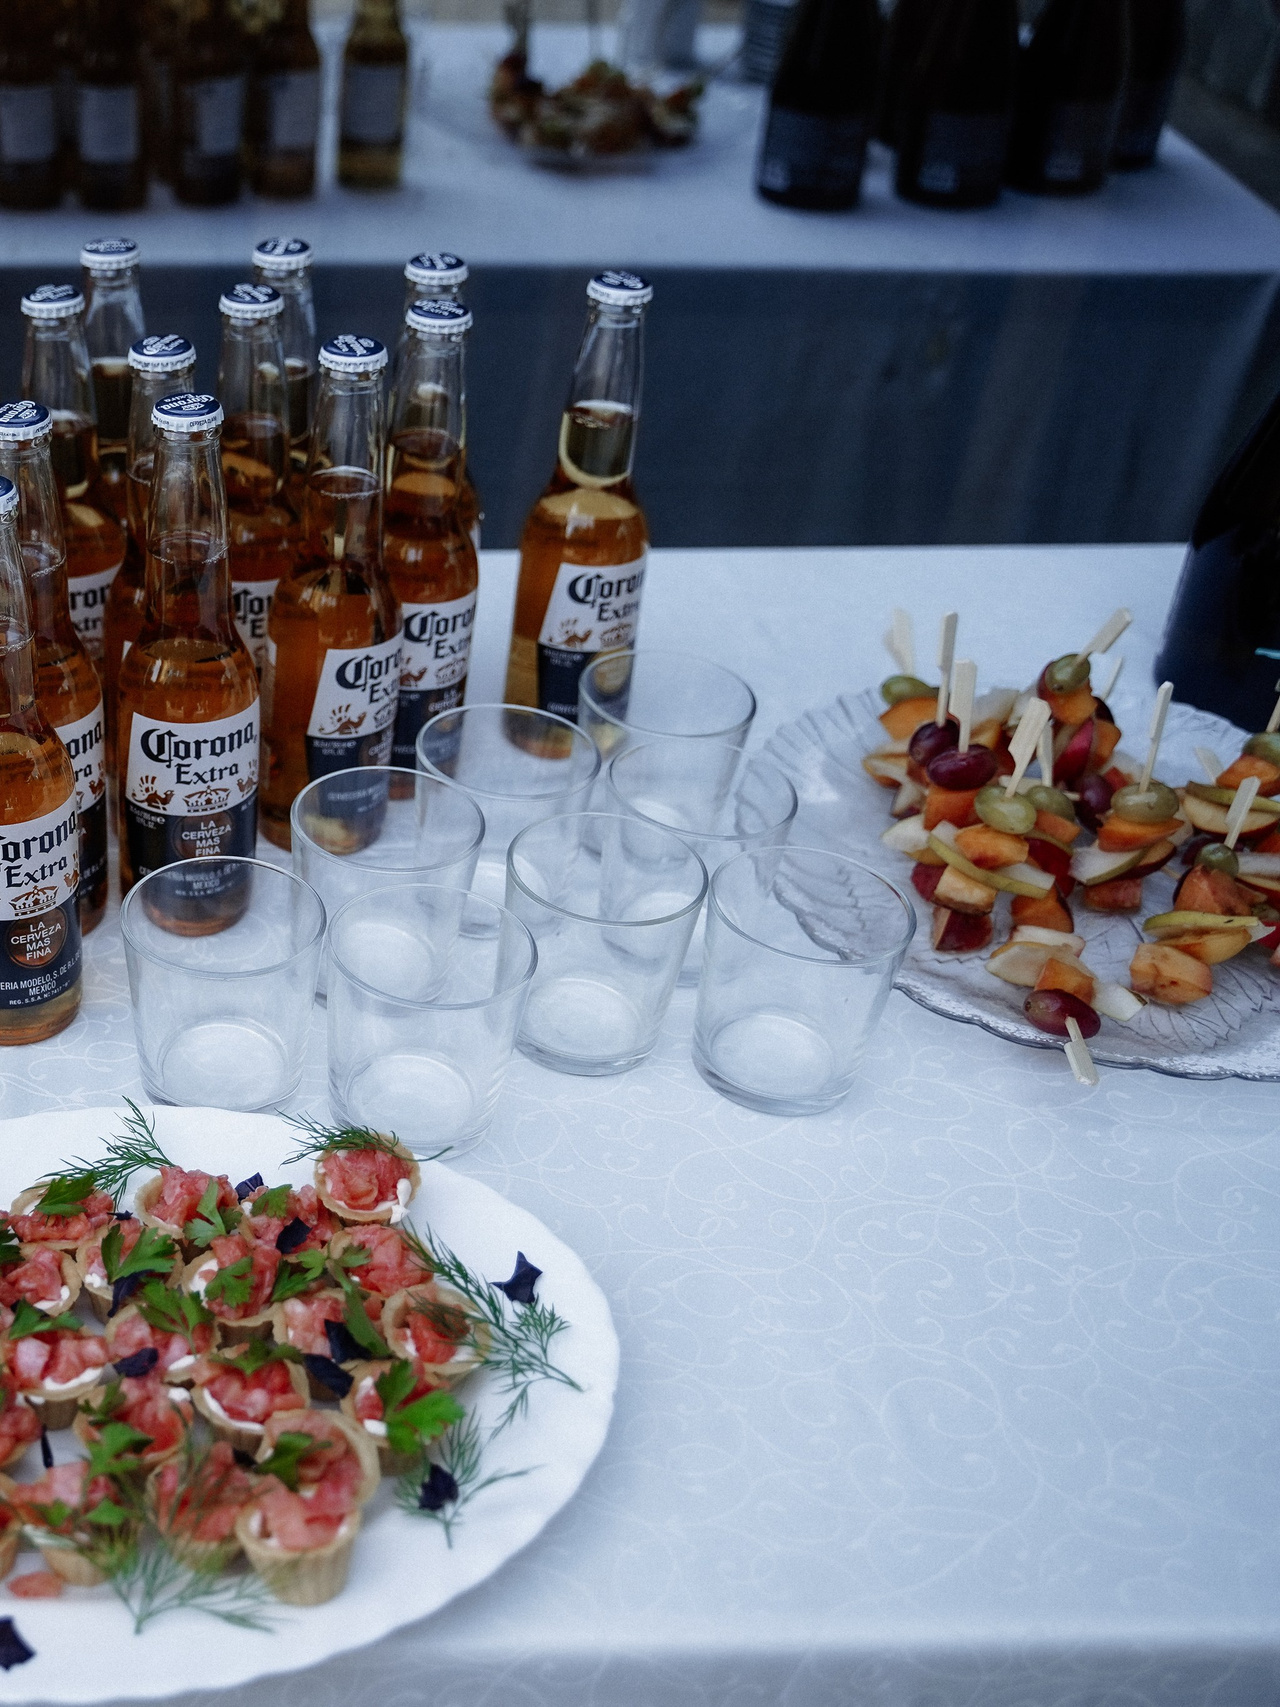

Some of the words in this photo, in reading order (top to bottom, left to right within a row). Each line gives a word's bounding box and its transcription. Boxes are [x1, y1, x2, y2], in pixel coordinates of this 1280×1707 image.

[157, 394, 215, 410] Corona
[66, 721, 103, 760] ona
[140, 720, 254, 768] Corona
[175, 763, 239, 786] Extra
[182, 824, 232, 840] CERVEZA
[201, 820, 216, 830] LA
[195, 837, 221, 848] MAS
[195, 846, 221, 857] FINA
[4, 856, 68, 888] Extra
[10, 922, 62, 945] CERVEZA
[29, 921, 46, 933] LA
[26, 937, 51, 952] MAS
[26, 946, 52, 961] FINA
[20, 972, 53, 989] MODELO,
[28, 980, 57, 996] MEXICO
